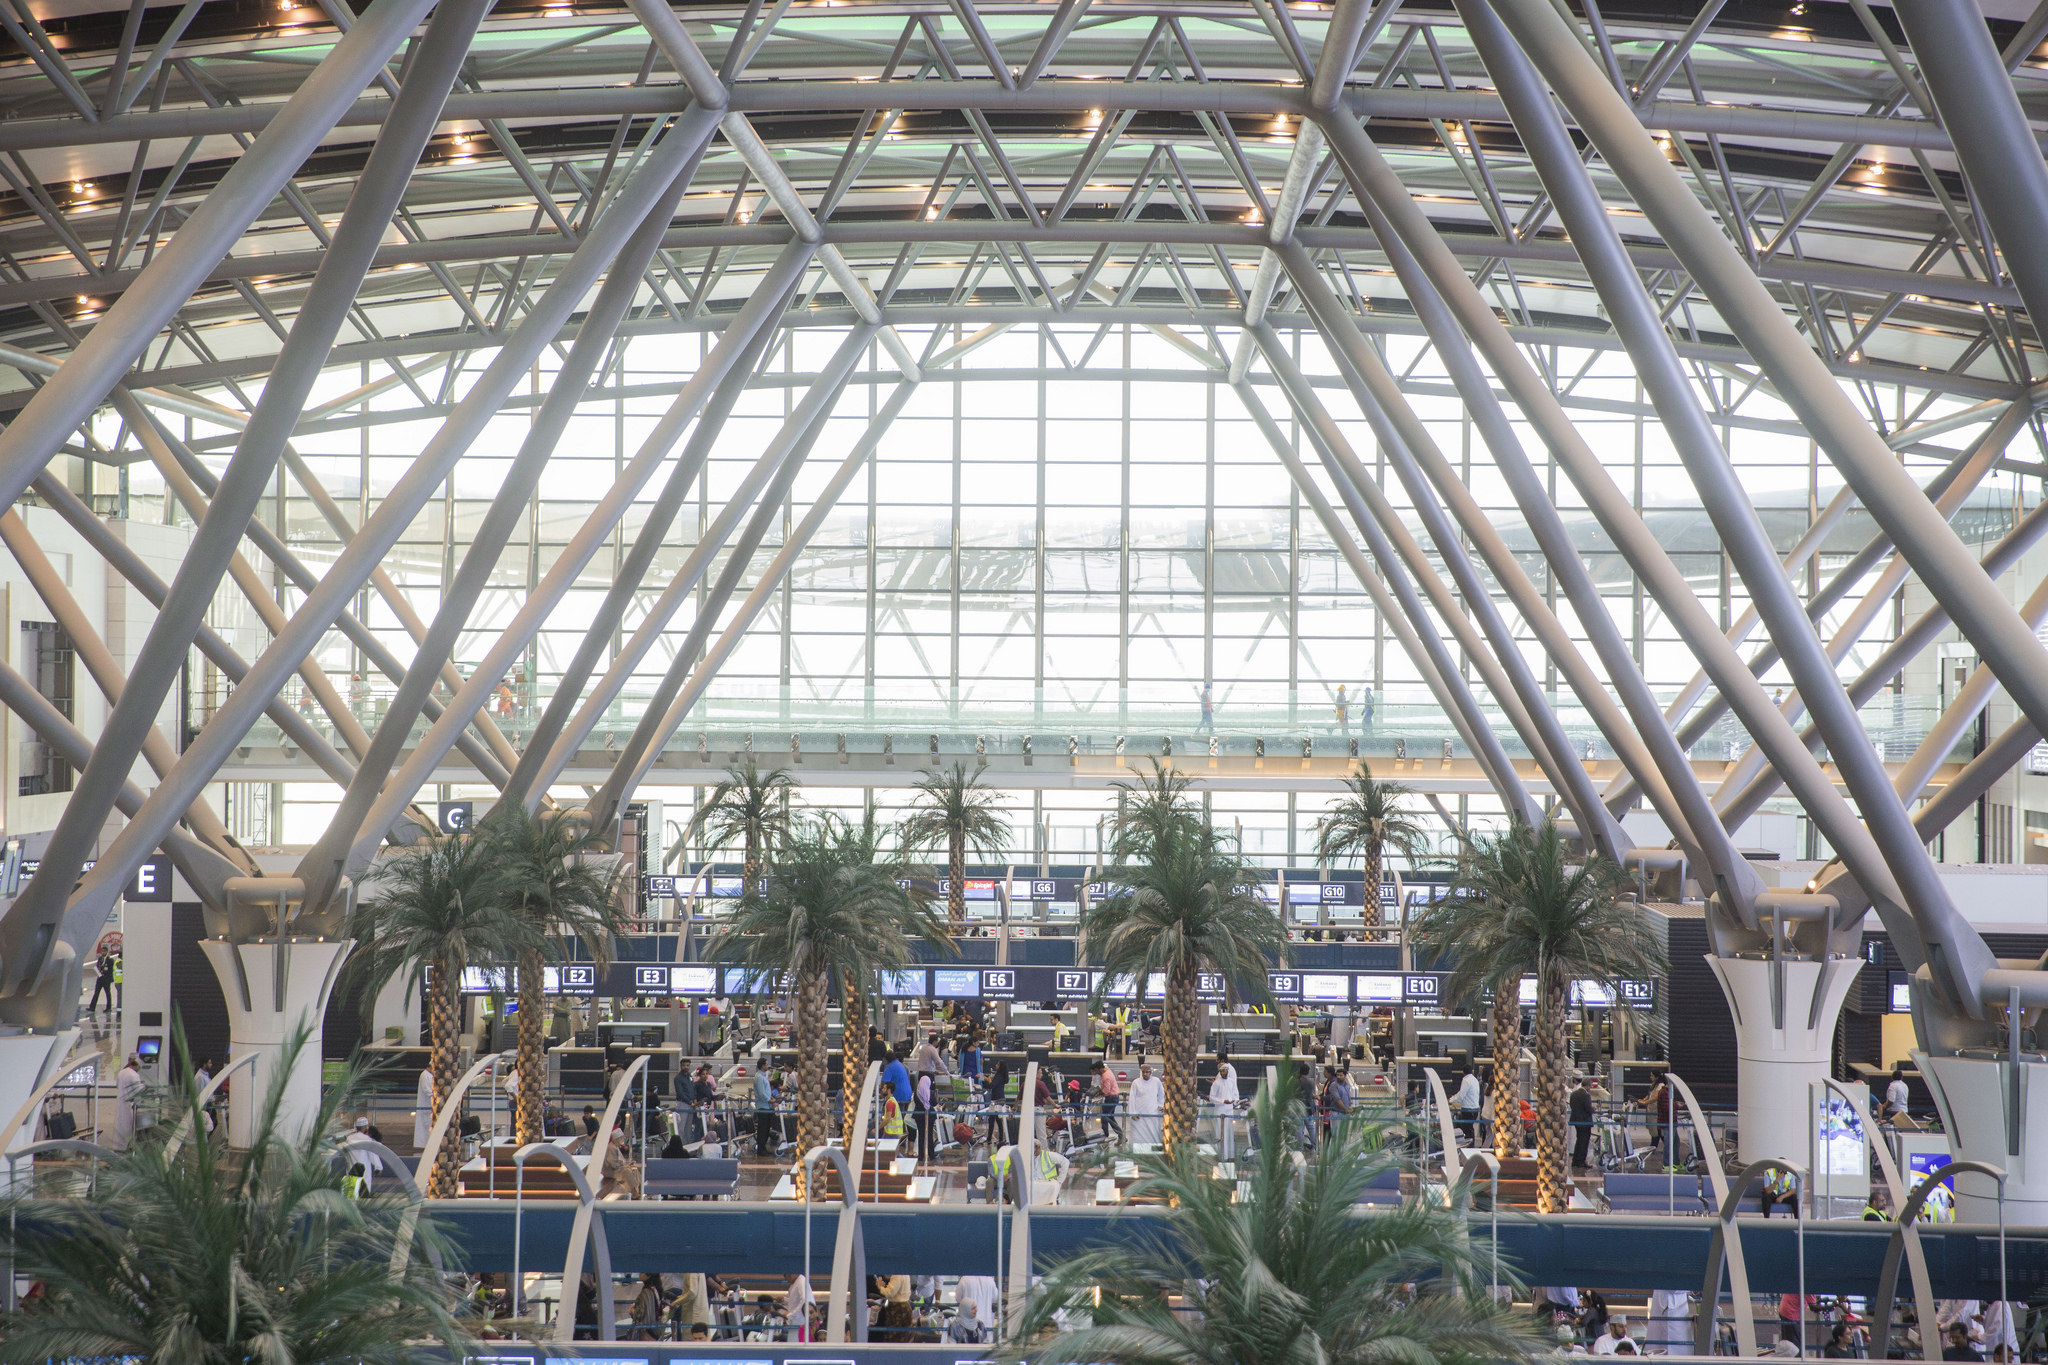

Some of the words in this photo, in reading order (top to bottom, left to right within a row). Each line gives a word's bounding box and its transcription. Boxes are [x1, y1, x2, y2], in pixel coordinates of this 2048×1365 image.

[138, 864, 156, 893] E
[1037, 884, 1051, 893] G6
[1325, 887, 1343, 896] G10
[570, 970, 587, 983] E2
[643, 970, 660, 983] E3
[989, 973, 1006, 986] E6
[1064, 974, 1080, 987] E7
[1201, 976, 1218, 989] E8
[1275, 977, 1292, 990] E9
[1410, 980, 1434, 993] E10
[1624, 983, 1648, 997] E12
